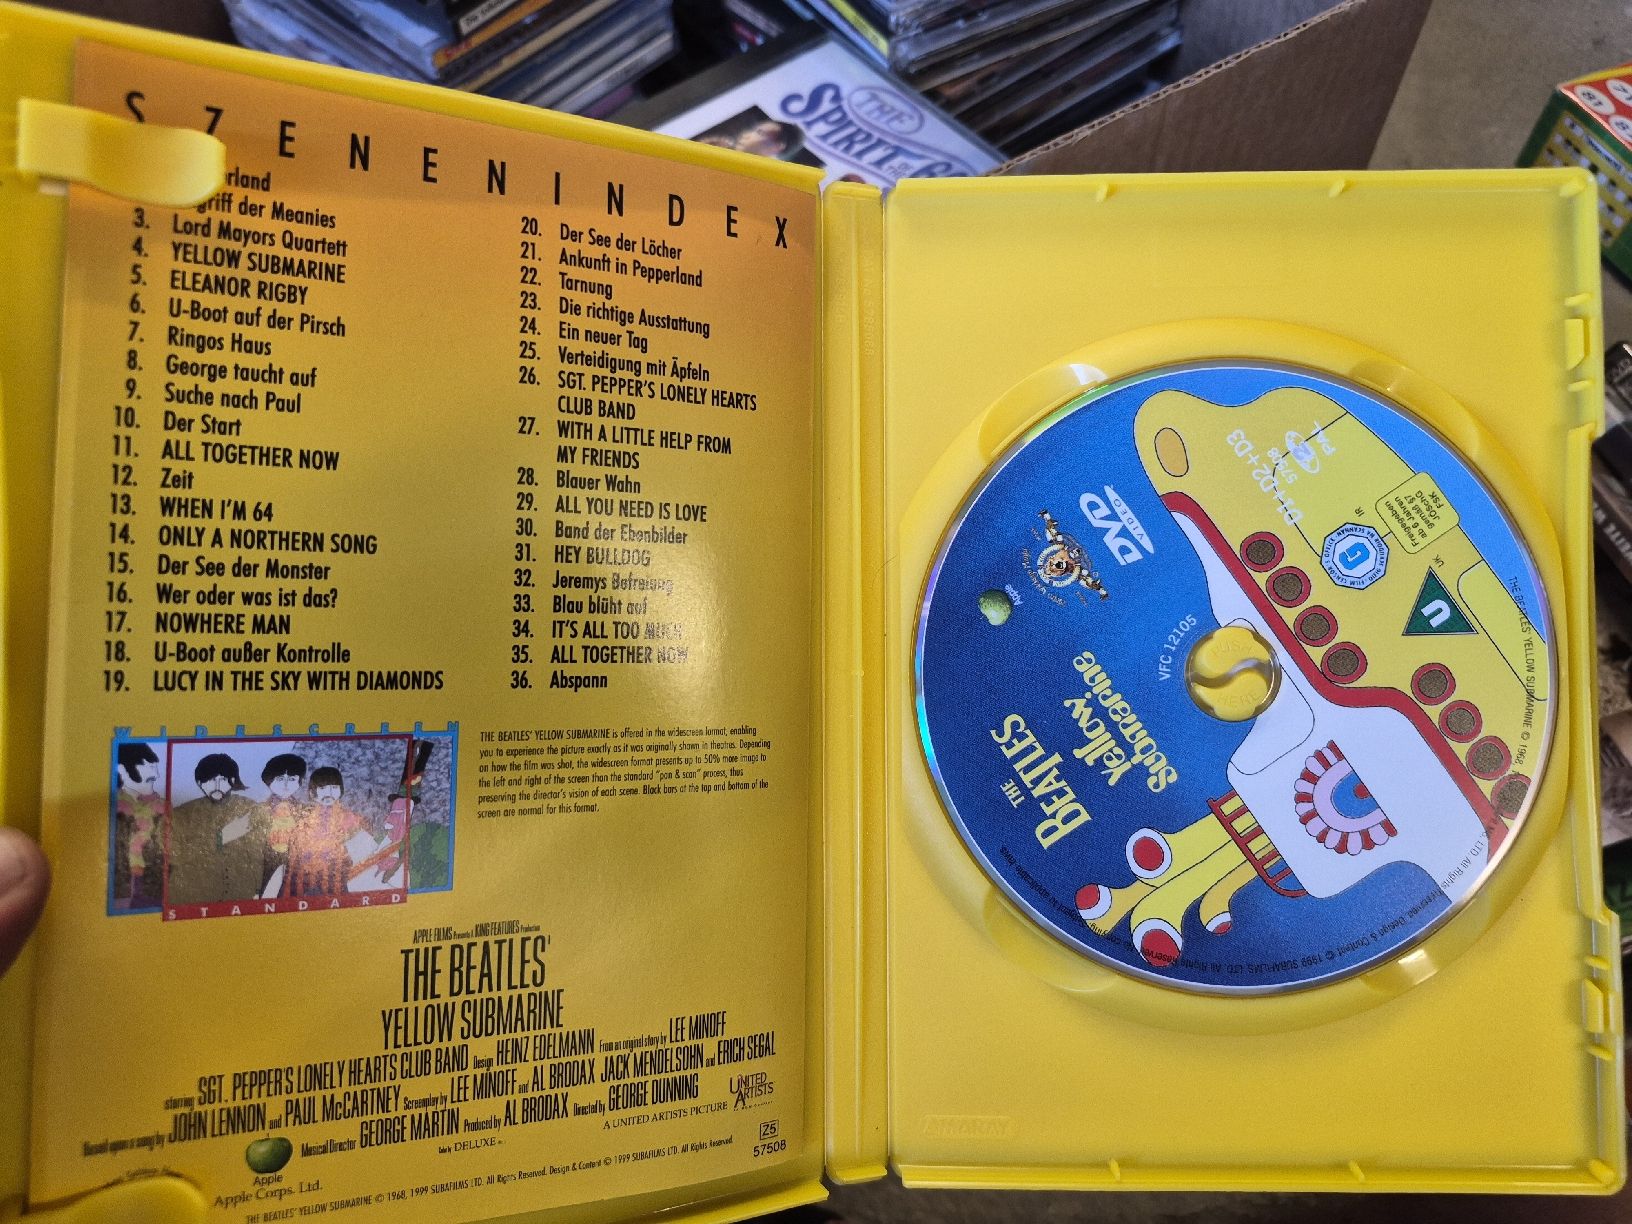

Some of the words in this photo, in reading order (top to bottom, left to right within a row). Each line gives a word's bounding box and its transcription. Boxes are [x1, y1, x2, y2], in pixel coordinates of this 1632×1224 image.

[133, 208, 150, 229] 3.
[173, 214, 212, 238] Lord
[218, 220, 276, 248] Mayors
[282, 230, 348, 258] Quartett
[521, 217, 542, 237] 20.
[561, 223, 584, 244] Der
[589, 228, 611, 248] See
[616, 233, 637, 253] der
[642, 237, 682, 260] Löcher
[133, 236, 149, 257] 4.
[172, 241, 242, 270] YELLOW
[247, 252, 346, 284] SUBMARINE
[521, 241, 542, 262] 21.
[559, 248, 612, 272] Ankunft
[616, 258, 628, 275] in
[633, 260, 703, 288] Pepperland
[131, 264, 147, 286] 5.
[170, 270, 251, 299] ELEANOR
[257, 281, 309, 305] RIGBY
[130, 293, 146, 314] 6.
[169, 298, 229, 324] U-Boot
[234, 306, 263, 328] auf
[267, 309, 295, 331] der
[300, 313, 346, 337] Pirsch
[520, 316, 541, 336] 24.
[560, 321, 580, 341] Ein
[585, 330, 623, 347] neuer
[626, 330, 648, 354] Tag
[127, 350, 143, 372] 8.
[166, 354, 228, 383] George
[234, 363, 285, 385] taucht
[290, 368, 318, 388] auf
[519, 366, 541, 386] 26.
[558, 371, 587, 391] SGT.
[592, 375, 656, 399] PEPPER'S
[661, 383, 708, 405] LONELY
[712, 390, 758, 411] HEARTS
[114, 406, 141, 429] 10.
[164, 410, 196, 433] Der
[201, 414, 242, 437] Start
[558, 395, 593, 416] CLUB
[599, 400, 636, 421] BAND
[113, 435, 139, 458] 11.
[162, 439, 196, 462] ALL
[202, 442, 293, 469] TOGETHER
[300, 449, 340, 471] NOW
[518, 417, 540, 436] 27.
[558, 420, 593, 441] WITH
[598, 425, 608, 443] A
[613, 426, 655, 447] LITTLE
[661, 431, 694, 451] HELP
[697, 435, 732, 455] FROM
[1312, 420, 1336, 455] PAL
[557, 445, 578, 464] MY
[583, 447, 640, 470] FRIENDS
[111, 493, 136, 516] 13.
[160, 496, 214, 520] WHEN
[221, 499, 247, 521] I'M
[253, 502, 274, 523] 64
[1113, 498, 1145, 541] VIDEO
[1354, 506, 1365, 517] IR
[1385, 501, 1419, 547] Freigegeben
[110, 522, 135, 545] 14.
[159, 525, 206, 548] ONLY
[211, 528, 224, 549] A
[231, 529, 325, 553] NORTHERN
[331, 534, 378, 555] SONG
[1079, 492, 1143, 566] DVD
[1339, 542, 1370, 570] G
[1432, 554, 1444, 568] UK
[1005, 583, 1023, 606] Apple
[106, 610, 132, 633] 17.
[156, 612, 246, 635] NOWHERE
[252, 614, 291, 635] MAN
[1421, 599, 1451, 628] U
[1163, 614, 1197, 653] 12105
[106, 640, 131, 663] 18.
[155, 641, 216, 663] U-Boot
[222, 641, 271, 664] außer
[277, 643, 351, 664] Kontrolle
[1158, 655, 1173, 681] VFC
[104, 670, 130, 693] 19.
[154, 670, 200, 692] LUCY
[205, 671, 224, 692] IN
[231, 671, 265, 692] THE
[271, 671, 302, 692] SKY
[307, 671, 350, 691] WITH
[357, 671, 444, 691] DIAMONDS
[511, 670, 534, 690] 36.
[550, 670, 608, 693] Abspann
[1073, 651, 1178, 793] Submarine
[1064, 698, 1132, 786] Yellow
[990, 714, 1092, 849] BEATLES
[1000, 779, 1024, 808] THE
[401, 946, 443, 1003] THE
[449, 934, 551, 997] BEATLES'
[382, 1002, 456, 1050] YELLOW
[460, 988, 564, 1040] SUBMARINE
[670, 1016, 686, 1043] LEE
[689, 1011, 727, 1041] MINOFF
[198, 1075, 228, 1106] SGT.
[233, 1067, 294, 1101] PEPPER'S
[298, 1060, 345, 1094] LONELY
[349, 1053, 398, 1087] HEARTS
[401, 1047, 431, 1080] CLUB
[435, 1044, 469, 1075] BAND
[497, 1036, 530, 1067] HEINZ
[533, 1028, 595, 1062] EDELMANN
[451, 1075, 469, 1104] LEE
[473, 1069, 517, 1100] MINOFF
[519, 1080, 530, 1094] and
[532, 1064, 547, 1092] AL
[549, 1057, 595, 1091] BRODAX
[601, 1053, 629, 1083] JACK
[634, 1044, 704, 1079] MENDELSOHN
[706, 1054, 716, 1068] and
[718, 1038, 745, 1066] ERICH
[747, 1031, 776, 1060] SEGAL
[730, 1072, 767, 1094] UNITED
[504, 1100, 519, 1127] AL
[522, 1092, 569, 1124] BRODAX
[609, 1081, 649, 1111] GEORGE
[652, 1073, 699, 1105] DUNNING
[734, 1082, 774, 1109] ARTISTS
[169, 1110, 208, 1143] JOHN
[211, 1102, 266, 1138] LENNON
[270, 1114, 282, 1130] and
[285, 1098, 318, 1128] PAUL
[322, 1085, 401, 1123] McCARTNEY
[360, 1116, 407, 1149] GEORGE
[410, 1109, 459, 1142] MARTIN
[762, 1123, 777, 1136] Z5
[753, 1140, 787, 1157] 57508
[214, 1191, 253, 1209] Apple
[299, 1180, 323, 1193] Ltd.
[253, 1173, 283, 1187] Apple
